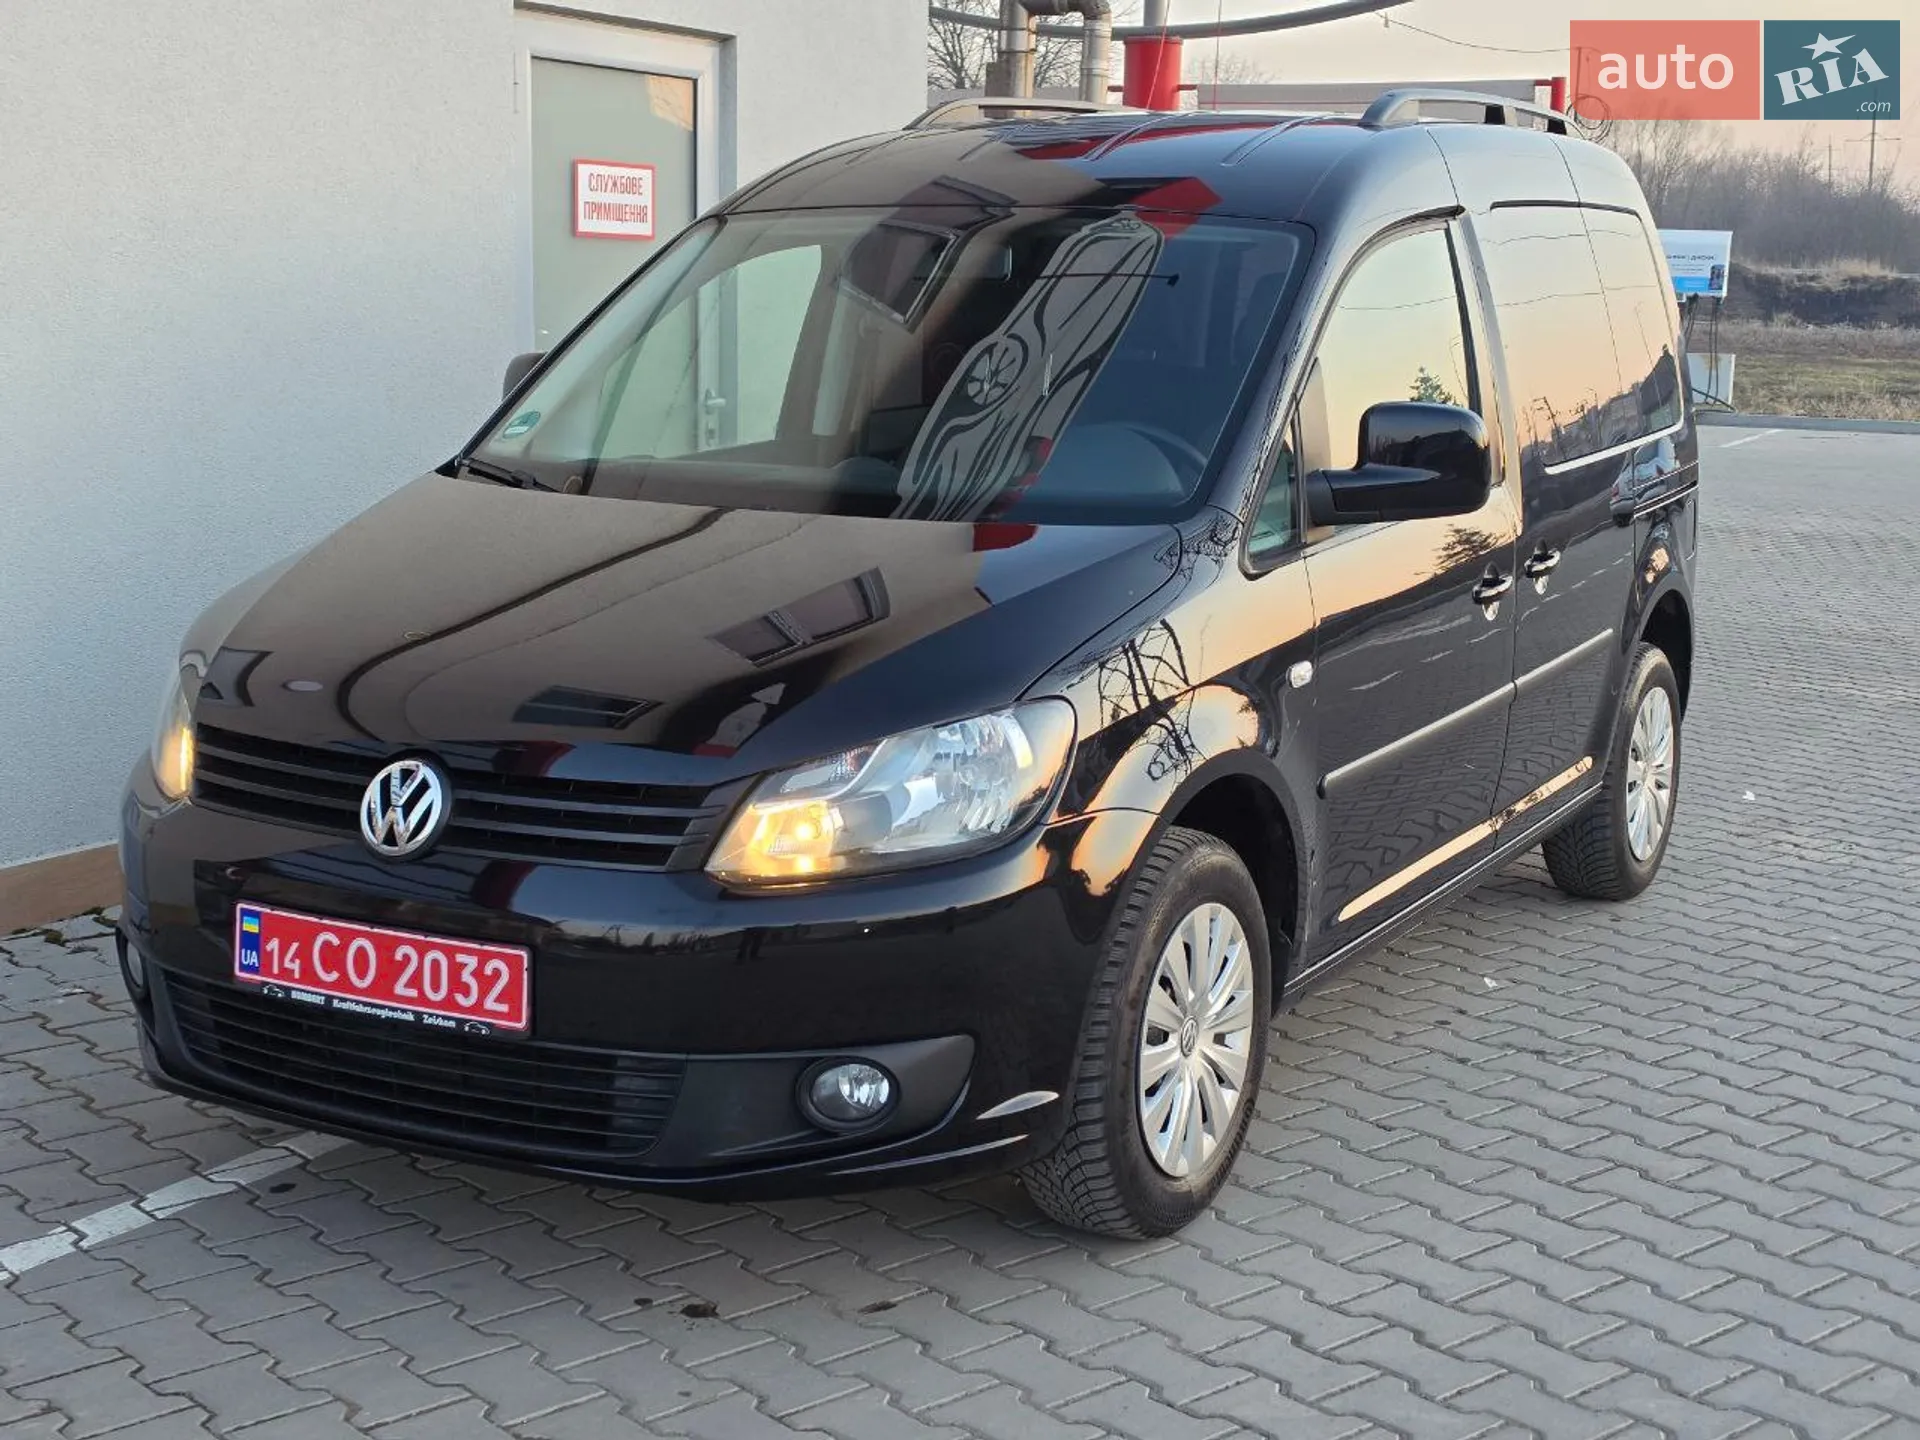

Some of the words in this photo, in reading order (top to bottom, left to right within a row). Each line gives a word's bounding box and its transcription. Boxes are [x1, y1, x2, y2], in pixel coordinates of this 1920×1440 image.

[588, 173, 643, 196] СЛУЖБОВЕ
[583, 201, 648, 223] ПРИМІЩЕННЯ
[241, 948, 259, 967] UA
[265, 937, 300, 979] 14
[312, 932, 377, 988] CO
[393, 945, 510, 1013] 2032
